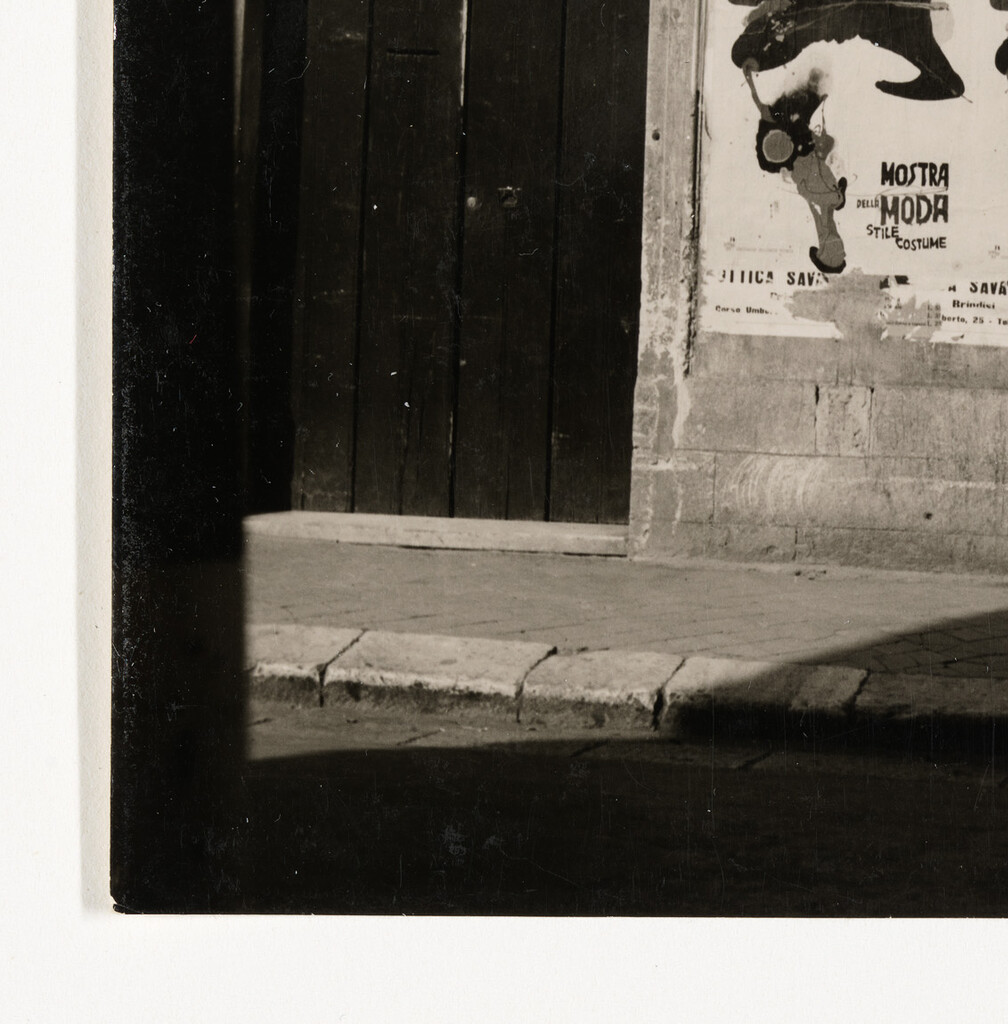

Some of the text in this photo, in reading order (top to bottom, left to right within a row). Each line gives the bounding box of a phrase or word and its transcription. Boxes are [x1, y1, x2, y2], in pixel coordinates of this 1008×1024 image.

[880, 161, 949, 189] MOSTRA
[880, 194, 949, 226] MODA
[866, 223, 900, 240] STILE
[895, 236, 948, 251] COSTUME
[951, 299, 996, 310] Brindisi
[972, 316, 985, 324] 25
